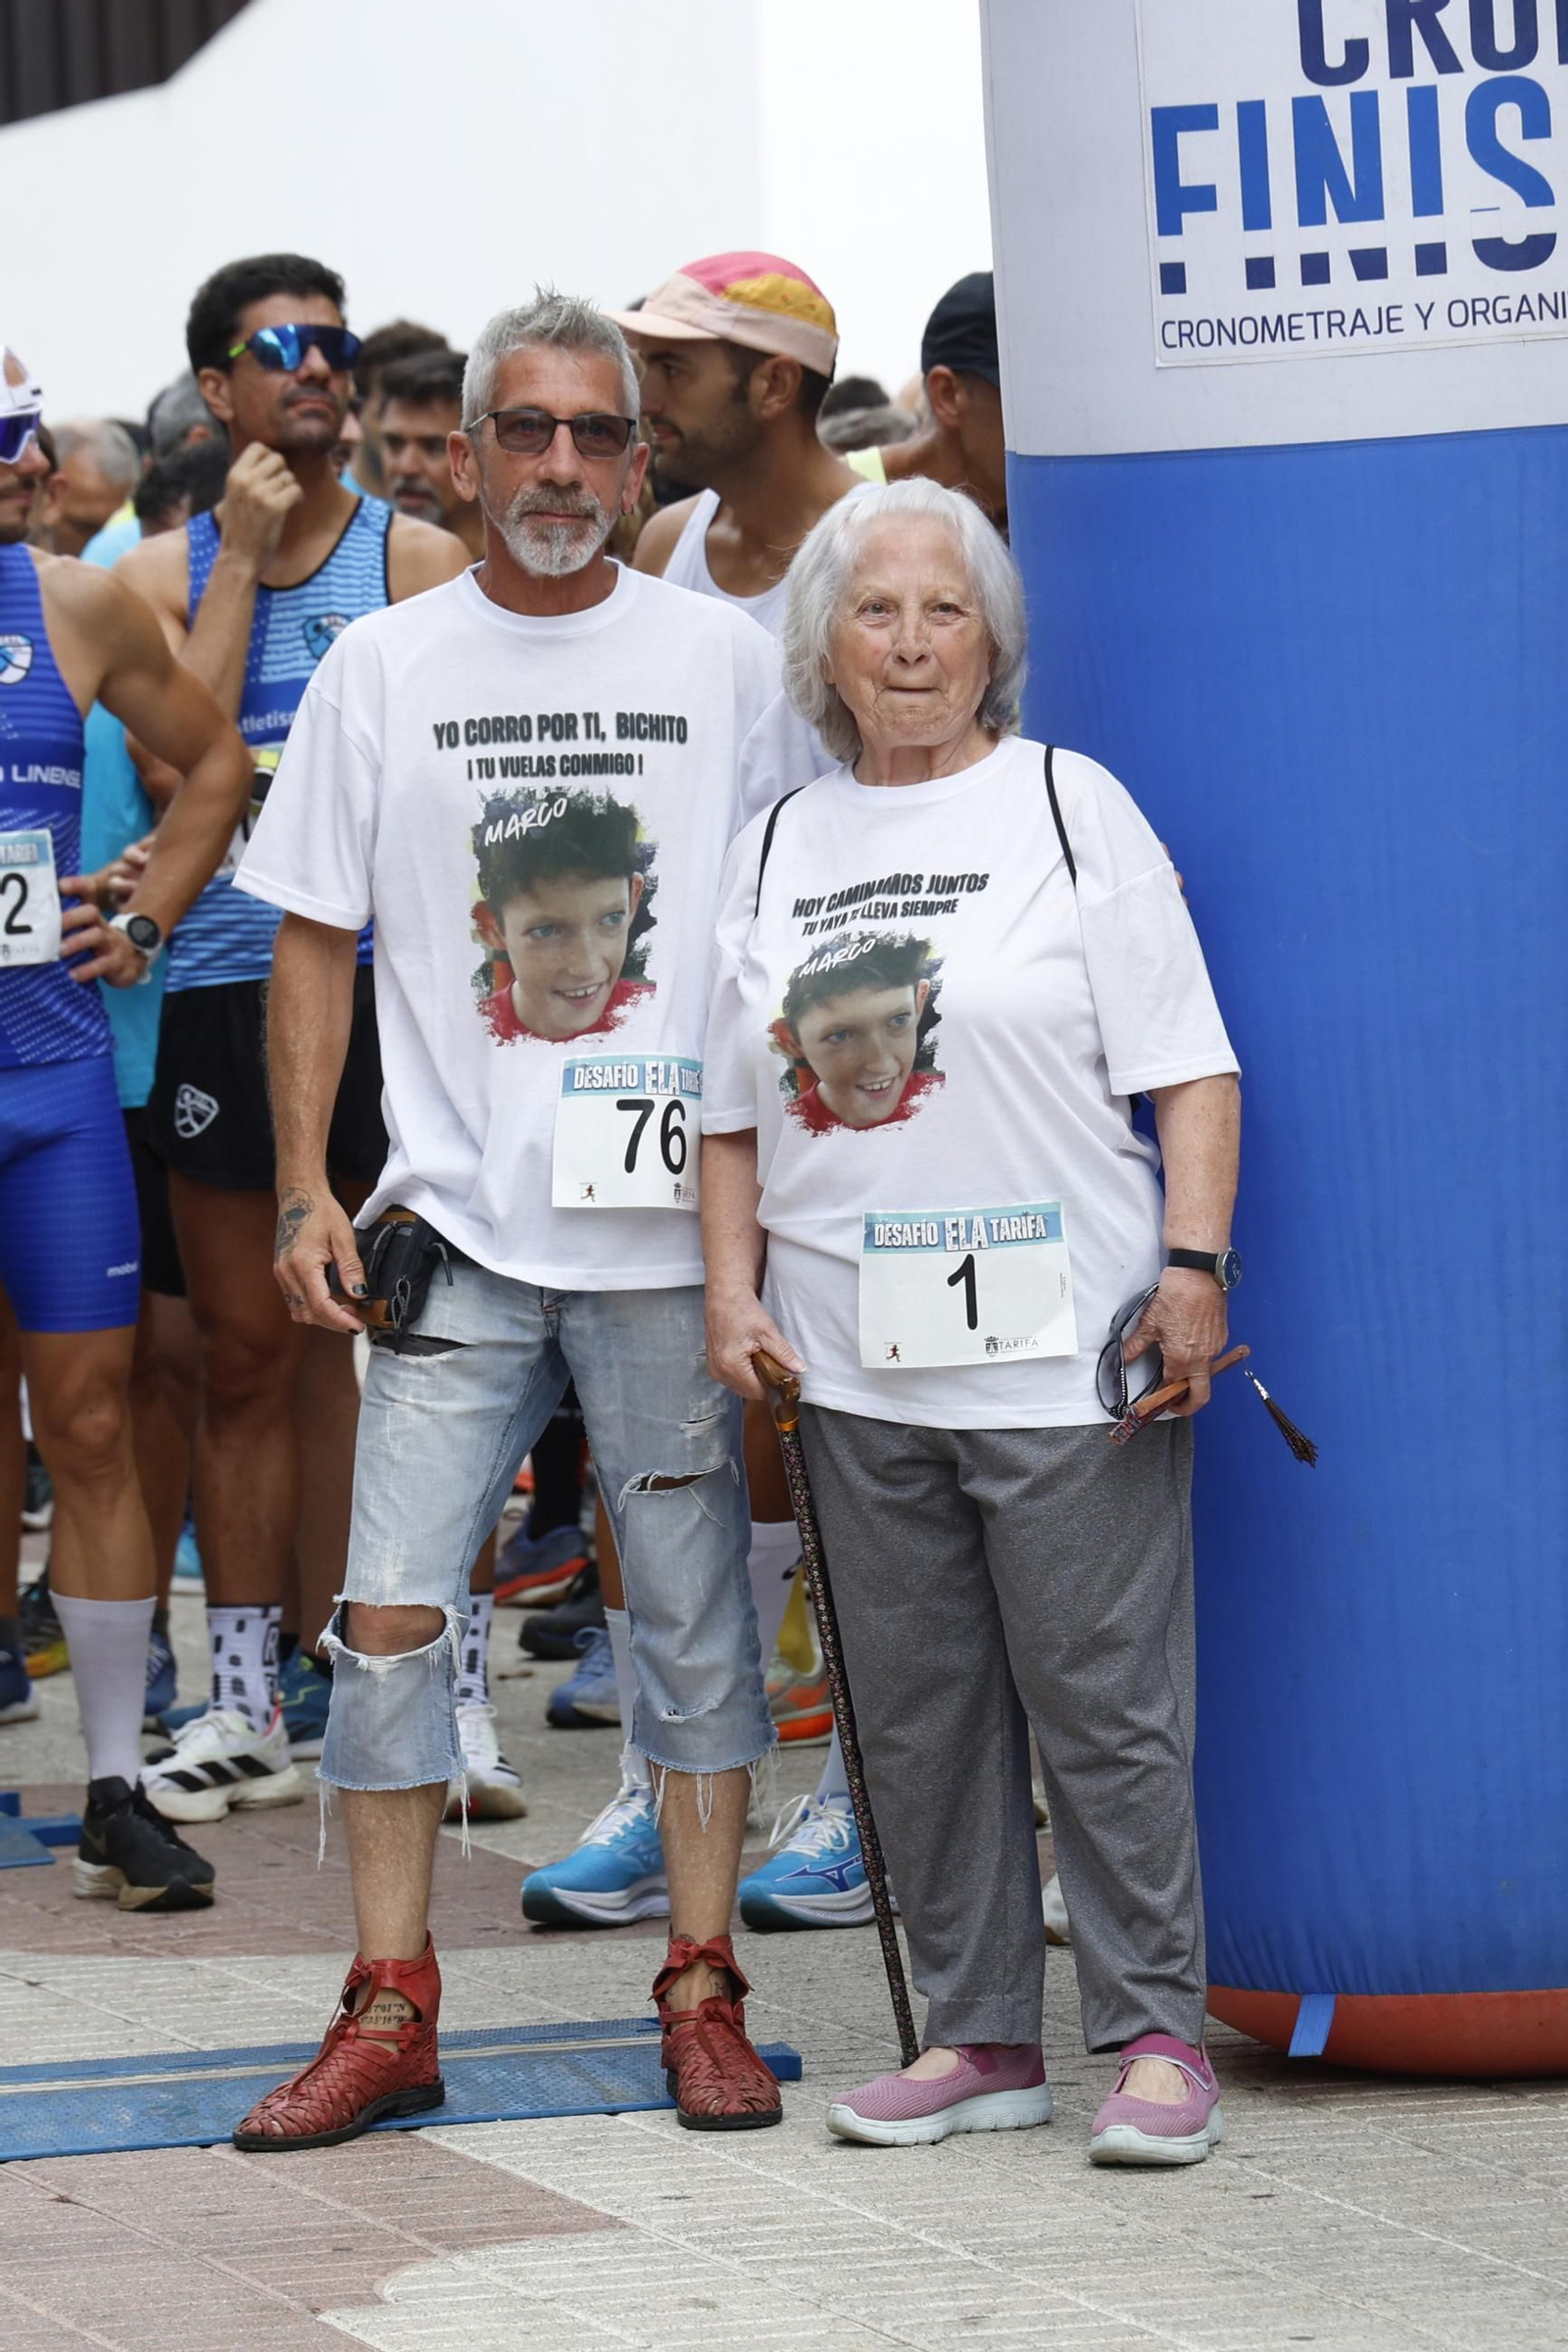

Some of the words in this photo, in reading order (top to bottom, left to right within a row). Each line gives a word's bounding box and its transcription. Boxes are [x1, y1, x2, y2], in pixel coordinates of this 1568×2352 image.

[1298, 0, 1568, 86] CRO
[1160, 304, 1404, 350] CRONOMETRAJE
[1414, 302, 1436, 331] Y
[1446, 290, 1568, 329] ORGANI
[433, 721, 460, 750] YO
[465, 714, 532, 747] CORRO
[538, 712, 578, 742] POR
[582, 711, 607, 742] TI,
[615, 711, 688, 745] BICHITO
[499, 755, 557, 778] VUELAS
[560, 753, 635, 776] CONMIGO
[484, 797, 568, 847] MARCO
[792, 896, 827, 918] HOY
[925, 873, 990, 896] JUNTOS
[802, 921, 818, 937] TU
[818, 911, 848, 934] YAYA
[859, 901, 898, 919] LLEVA
[901, 899, 959, 917] SIEMPRE
[798, 939, 877, 978] MARCO
[573, 1061, 639, 1090] DESAFÍO
[644, 1060, 680, 1096] ELA
[615, 1099, 687, 1175] 76
[874, 1220, 939, 1248] DESAFÍO
[945, 1215, 989, 1251] ELA
[990, 1215, 1047, 1243] TARIFA
[947, 1253, 978, 1331] 1
[999, 1339, 1040, 1350] TARIFA
